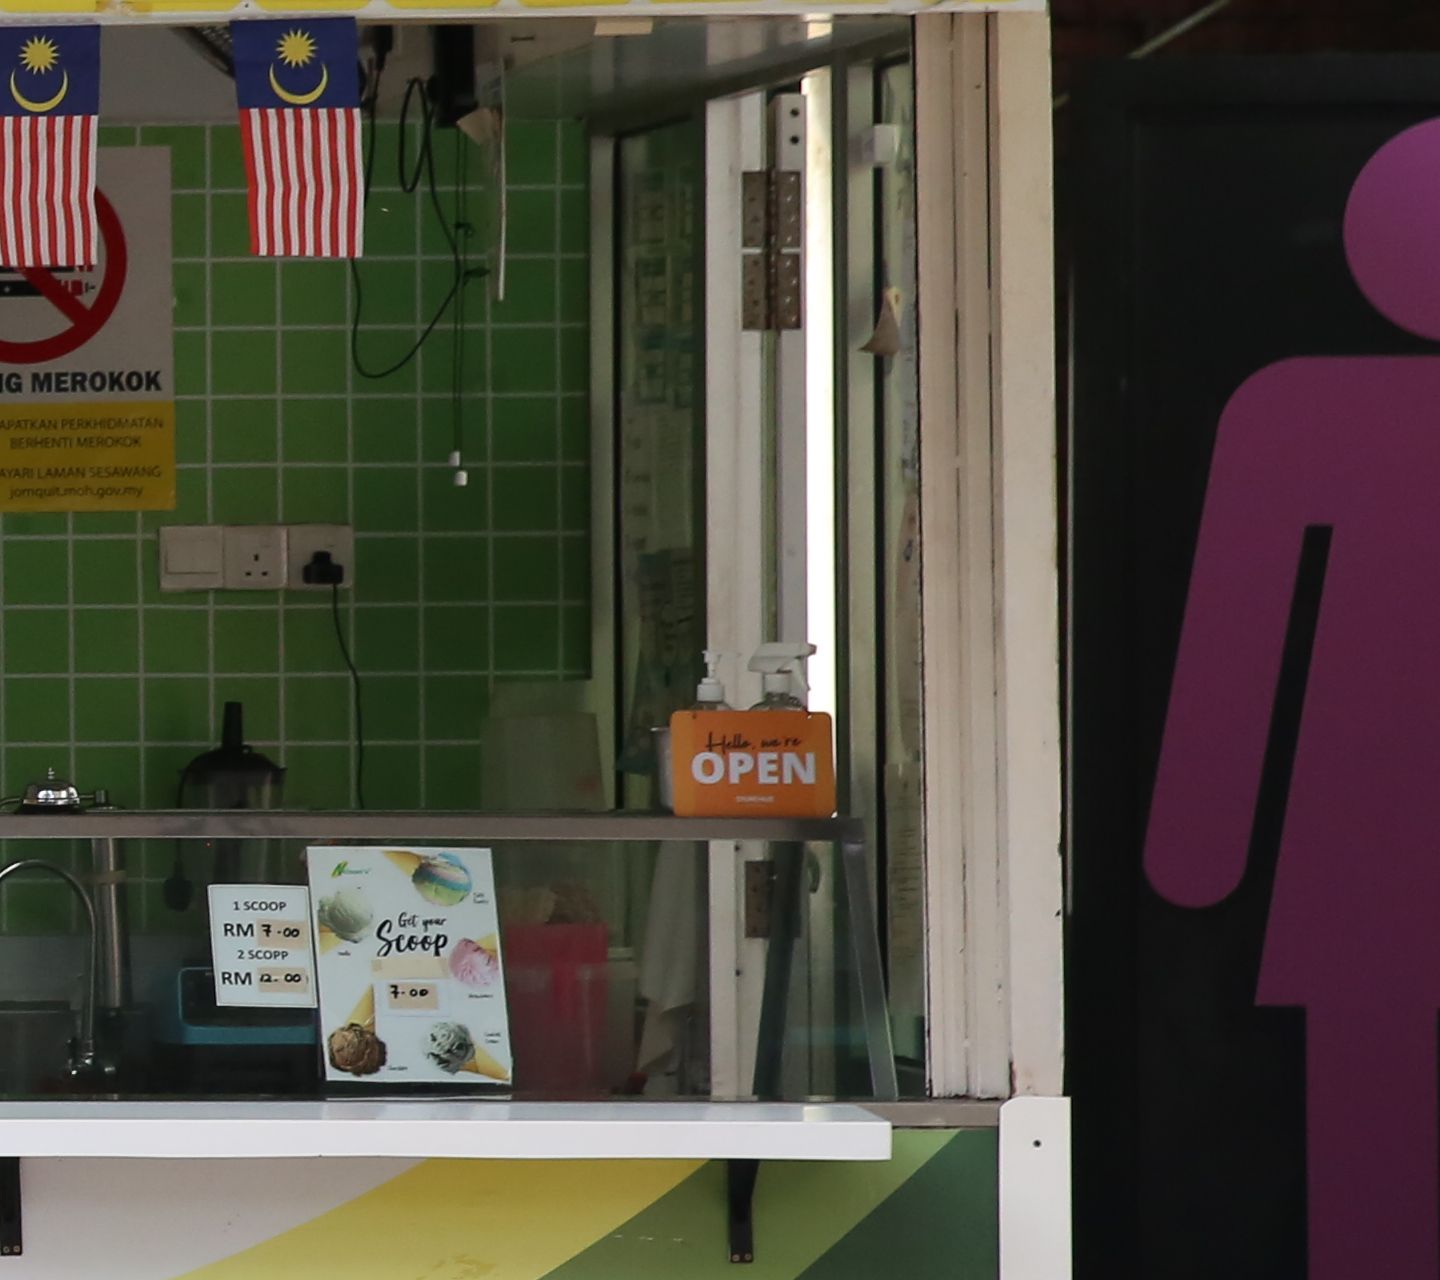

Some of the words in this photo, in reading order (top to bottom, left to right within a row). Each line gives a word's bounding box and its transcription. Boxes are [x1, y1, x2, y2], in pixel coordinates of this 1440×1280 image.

[31, 370, 161, 392] MEROKOK
[61, 418, 164, 430] PERKHIDMATAN
[10, 438, 73, 449] BERHENTI
[77, 436, 141, 448] MEROKOK
[38, 468, 85, 479] LAMAN
[89, 466, 161, 478] SESAWANG
[706, 732, 755, 754] Hello,
[691, 751, 815, 784] OPEN
[233, 902, 240, 911] 1
[244, 901, 286, 912] SCOOP
[398, 912, 418, 928] Get
[422, 916, 447, 932] your
[224, 924, 254, 937] RM
[261, 924, 300, 938] 7.00
[376, 920, 448, 958] Scoop
[237, 950, 244, 960] 2
[248, 950, 288, 960] SCOPP
[222, 972, 252, 985] RM
[390, 985, 429, 999] 7.00
